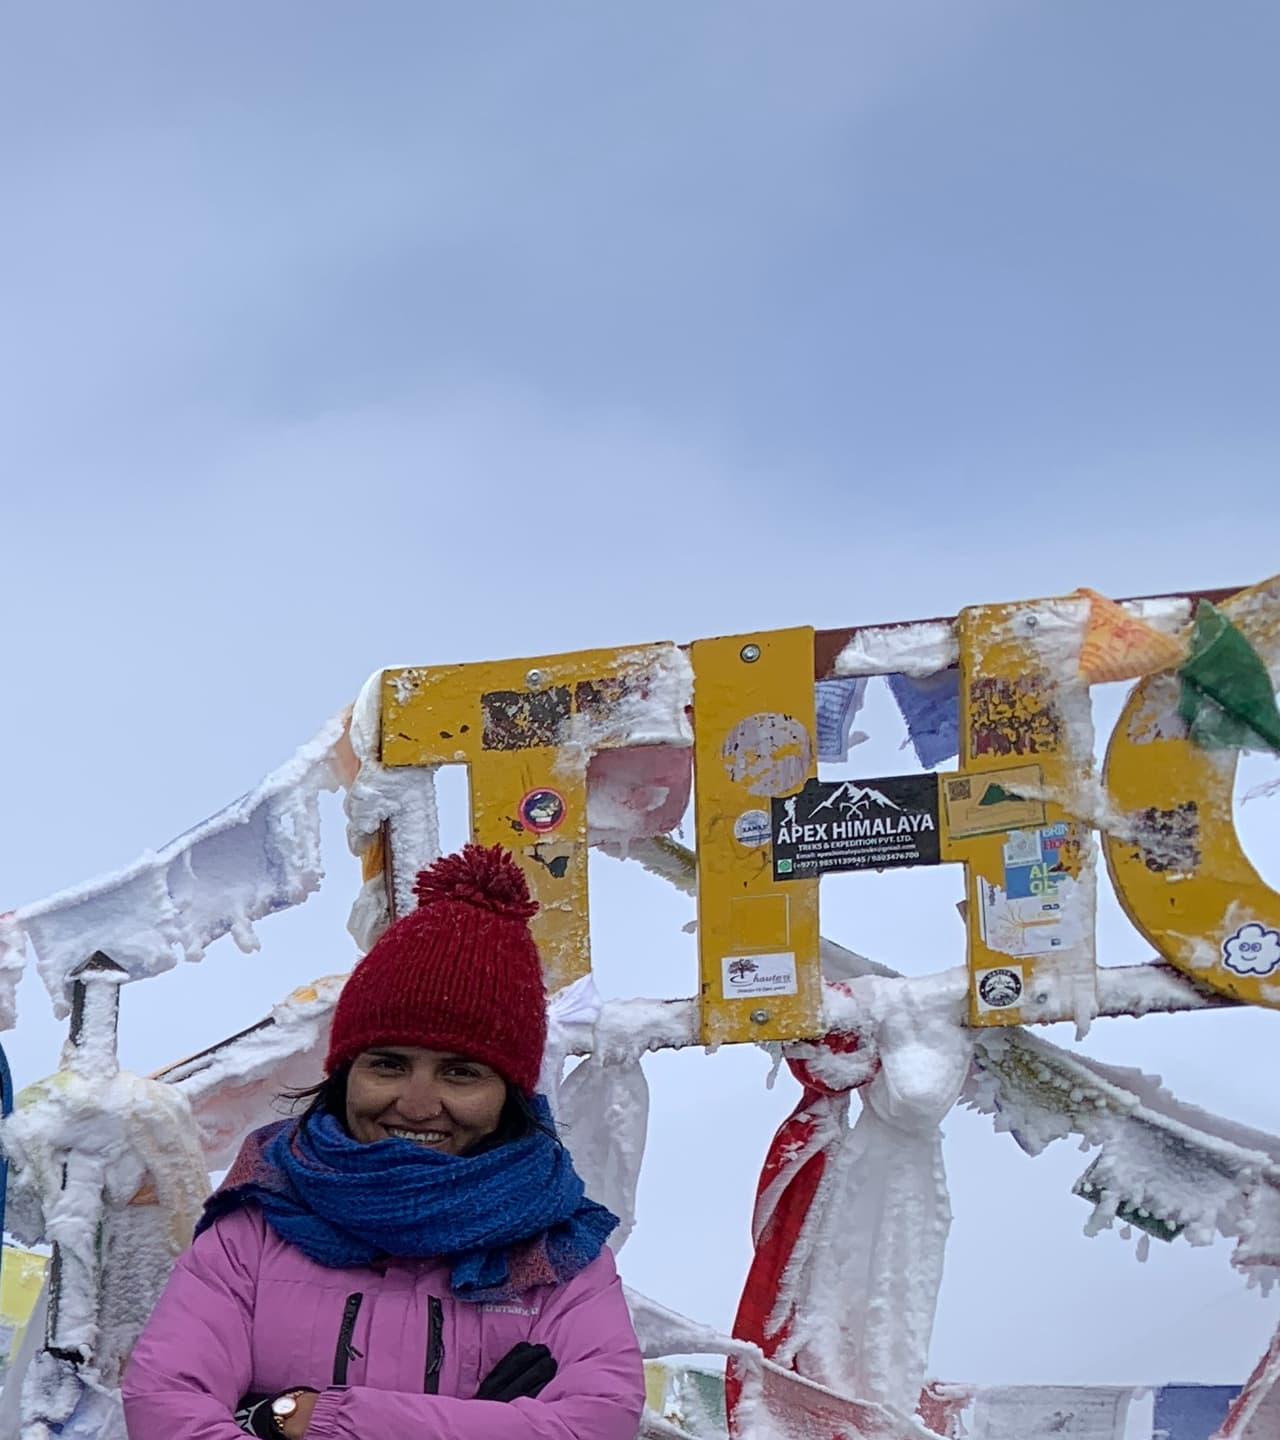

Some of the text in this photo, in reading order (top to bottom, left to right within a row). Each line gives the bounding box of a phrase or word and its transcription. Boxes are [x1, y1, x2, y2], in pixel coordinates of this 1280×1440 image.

[777, 814, 935, 844] APEX HIMALAYA
[798, 843, 823, 851] TREKS
[831, 838, 877, 849] EXPEDITION
[878, 836, 896, 845] PVT.
[896, 835, 914, 843] LTD.
